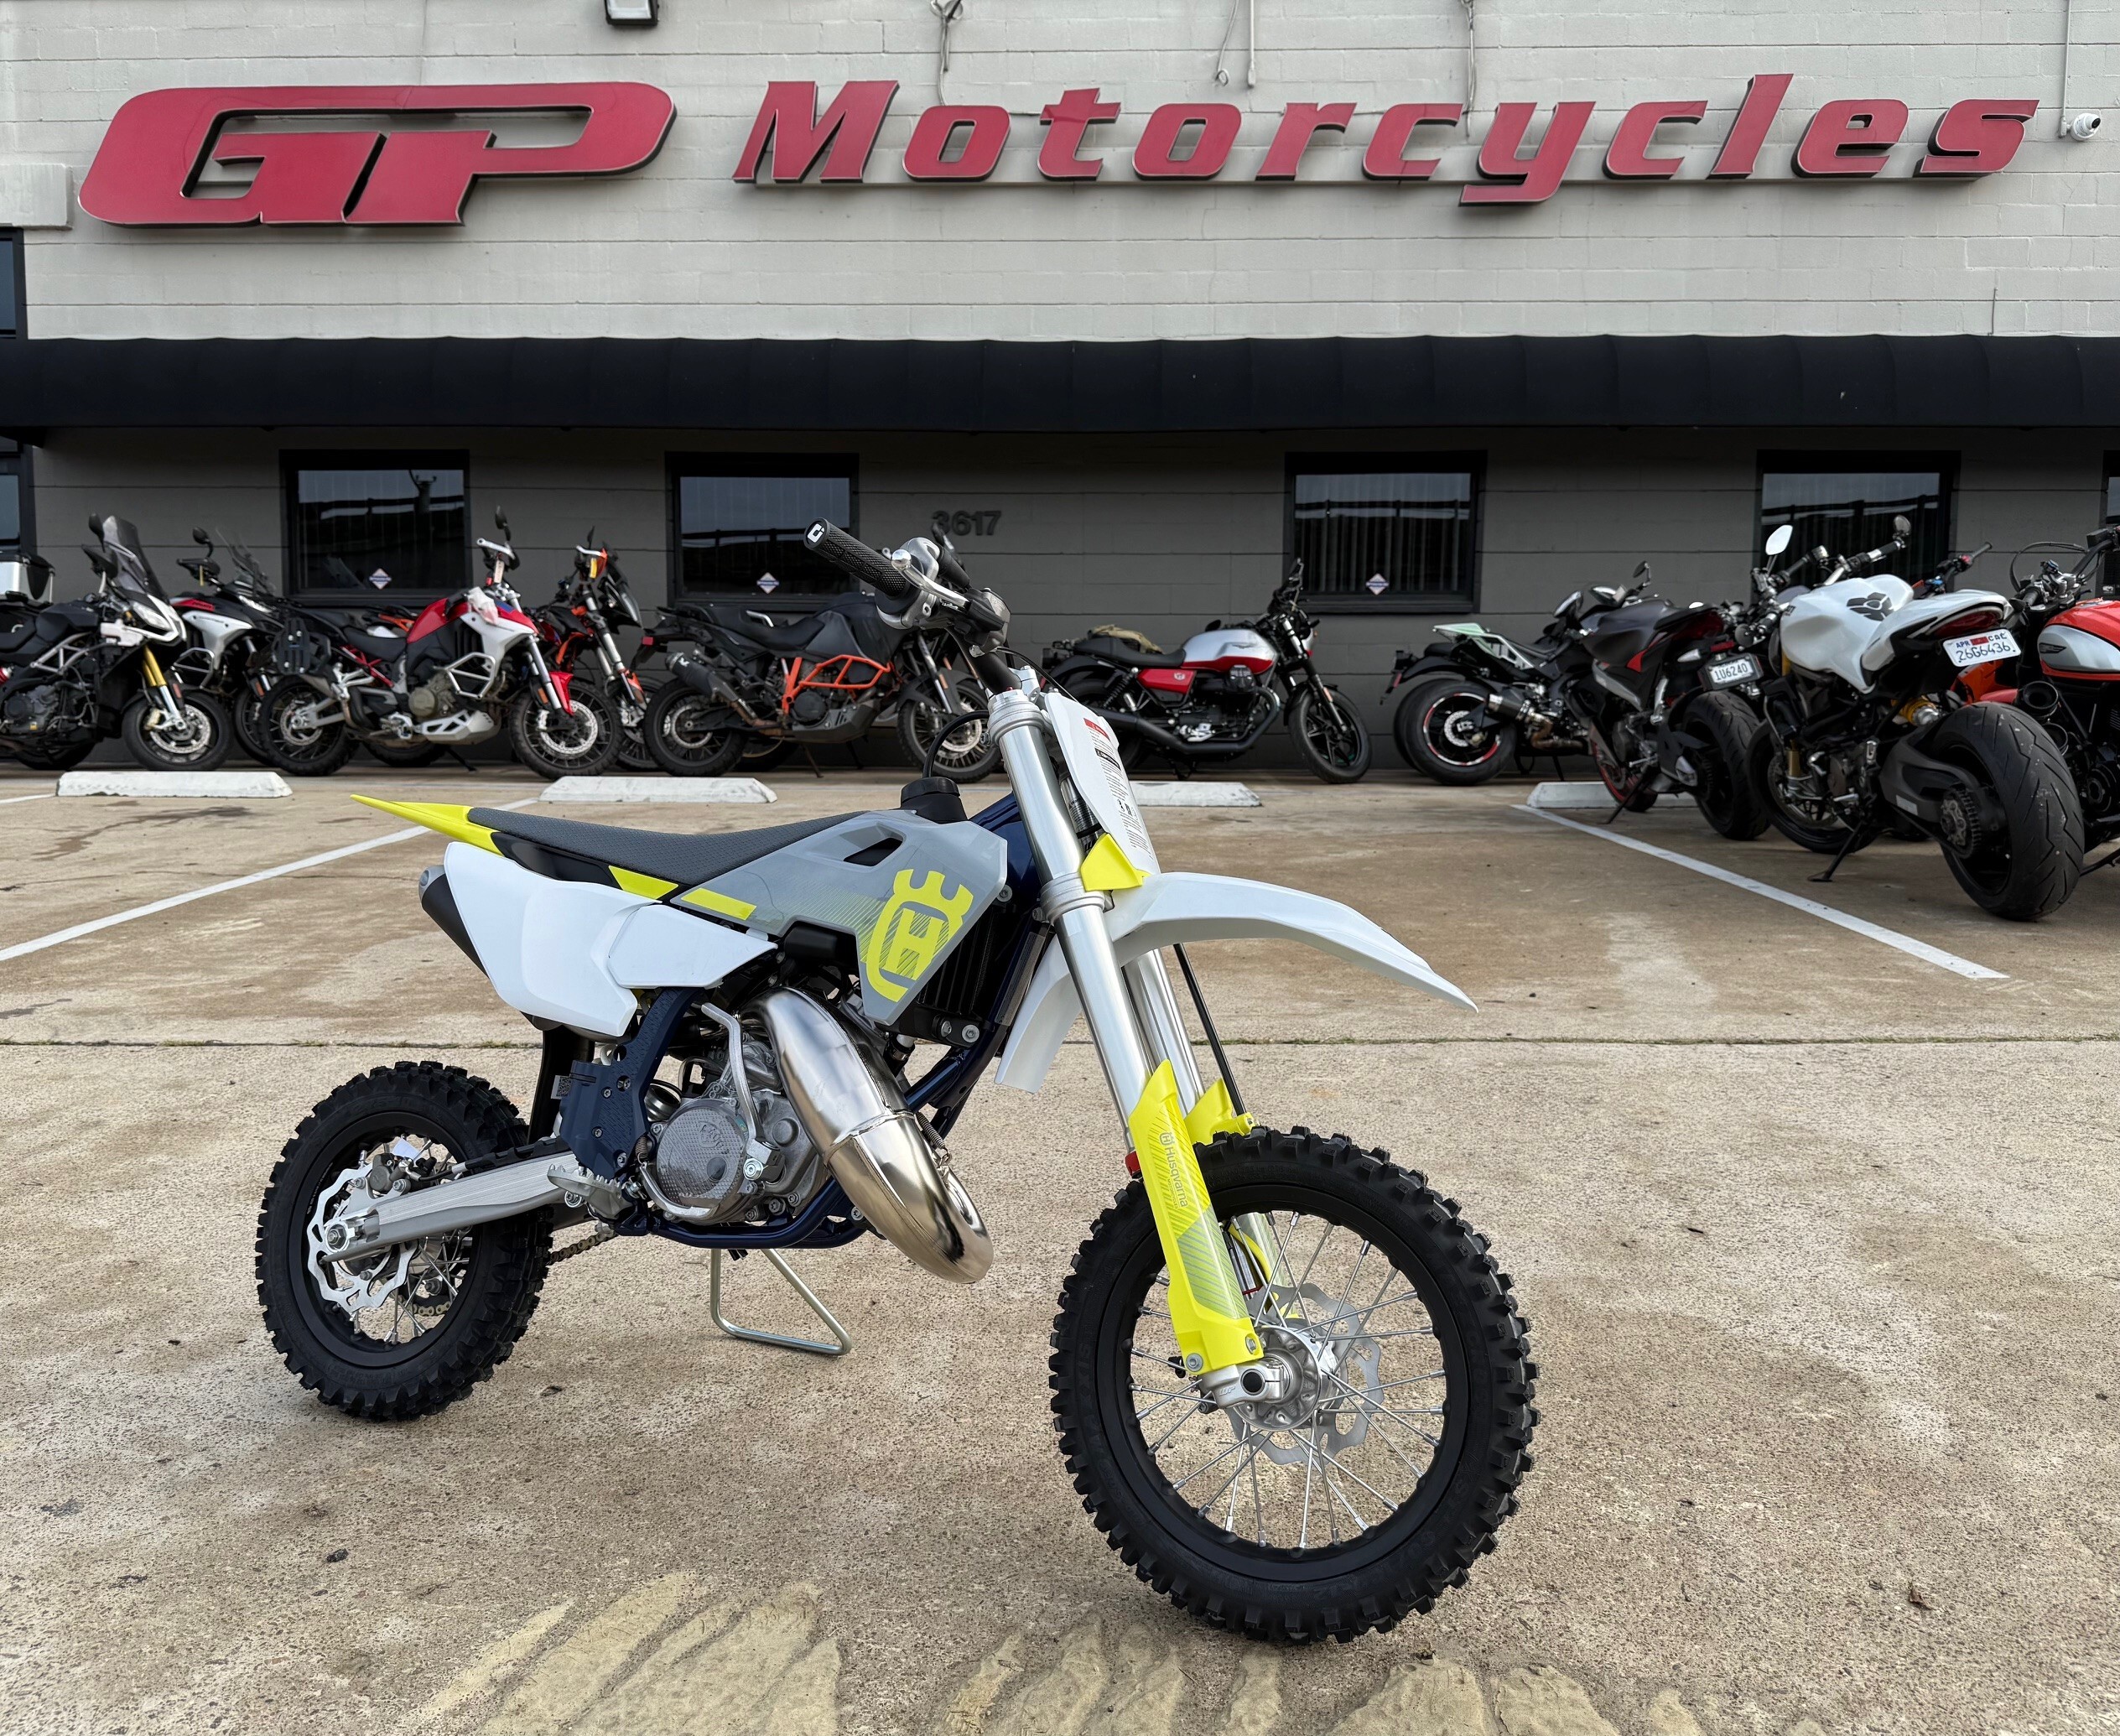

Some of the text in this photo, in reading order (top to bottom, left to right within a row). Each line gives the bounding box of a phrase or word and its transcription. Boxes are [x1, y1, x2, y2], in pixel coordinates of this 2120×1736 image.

[79, 71, 2039, 227] GP Motorcycles
[931, 510, 1002, 537] 3617
[1956, 640, 1971, 648] APR
[1164, 1146, 1188, 1208] Husqvarna
